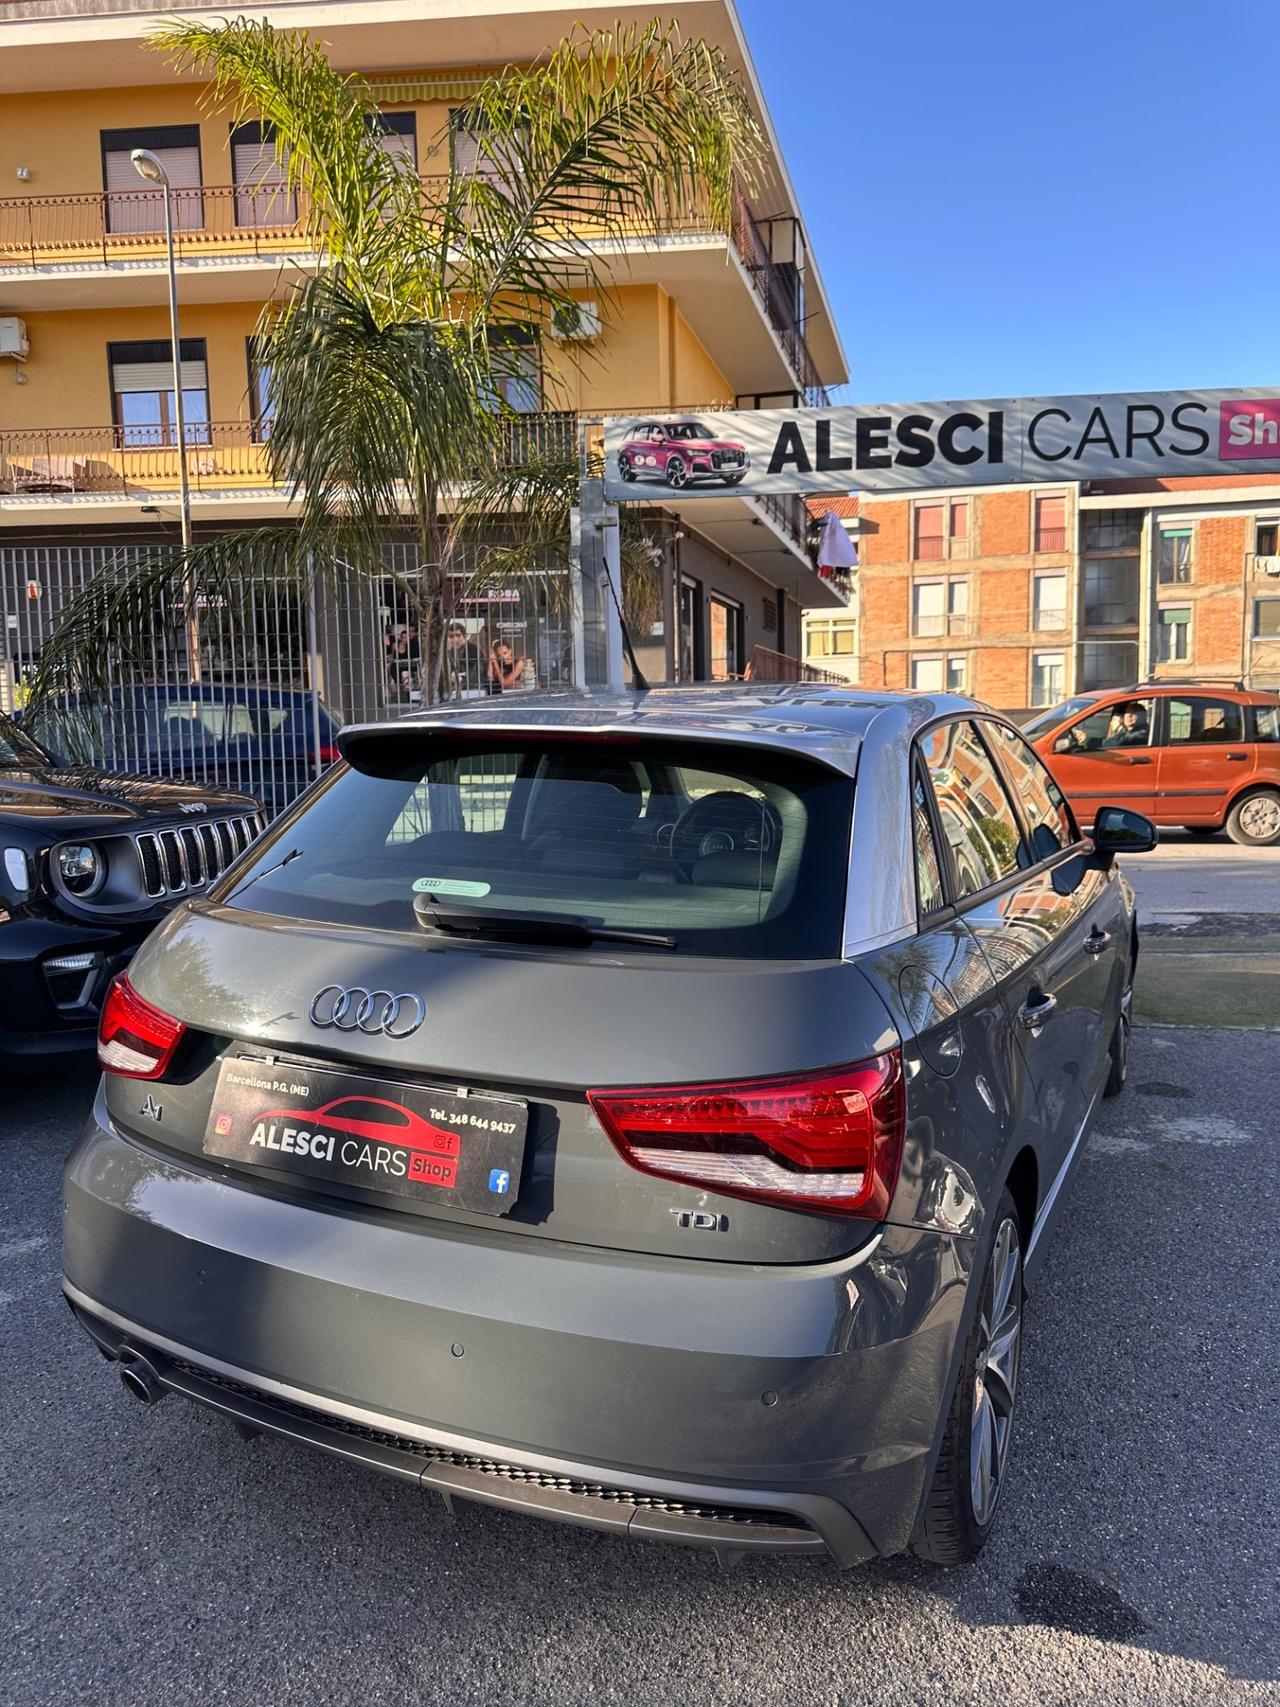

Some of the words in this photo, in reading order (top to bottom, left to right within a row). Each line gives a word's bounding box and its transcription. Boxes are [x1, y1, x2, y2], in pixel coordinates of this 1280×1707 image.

[767, 411, 1004, 474] ALESCI
[1028, 402, 1210, 462] CARS
[1228, 413, 1280, 446] Sh
[226, 1072, 272, 1090] Barcellona
[272, 1081, 289, 1094] P.G.
[289, 1084, 310, 1097] (ME)
[140, 1094, 163, 1121] A1
[448, 1113, 469, 1125] 348
[469, 1116, 489, 1130] 644
[490, 1121, 517, 1134] 9437
[249, 1122, 336, 1162] ALESCI
[341, 1141, 407, 1176] CARS
[412, 1158, 452, 1181] Shop
[670, 1209, 730, 1233] TDI
